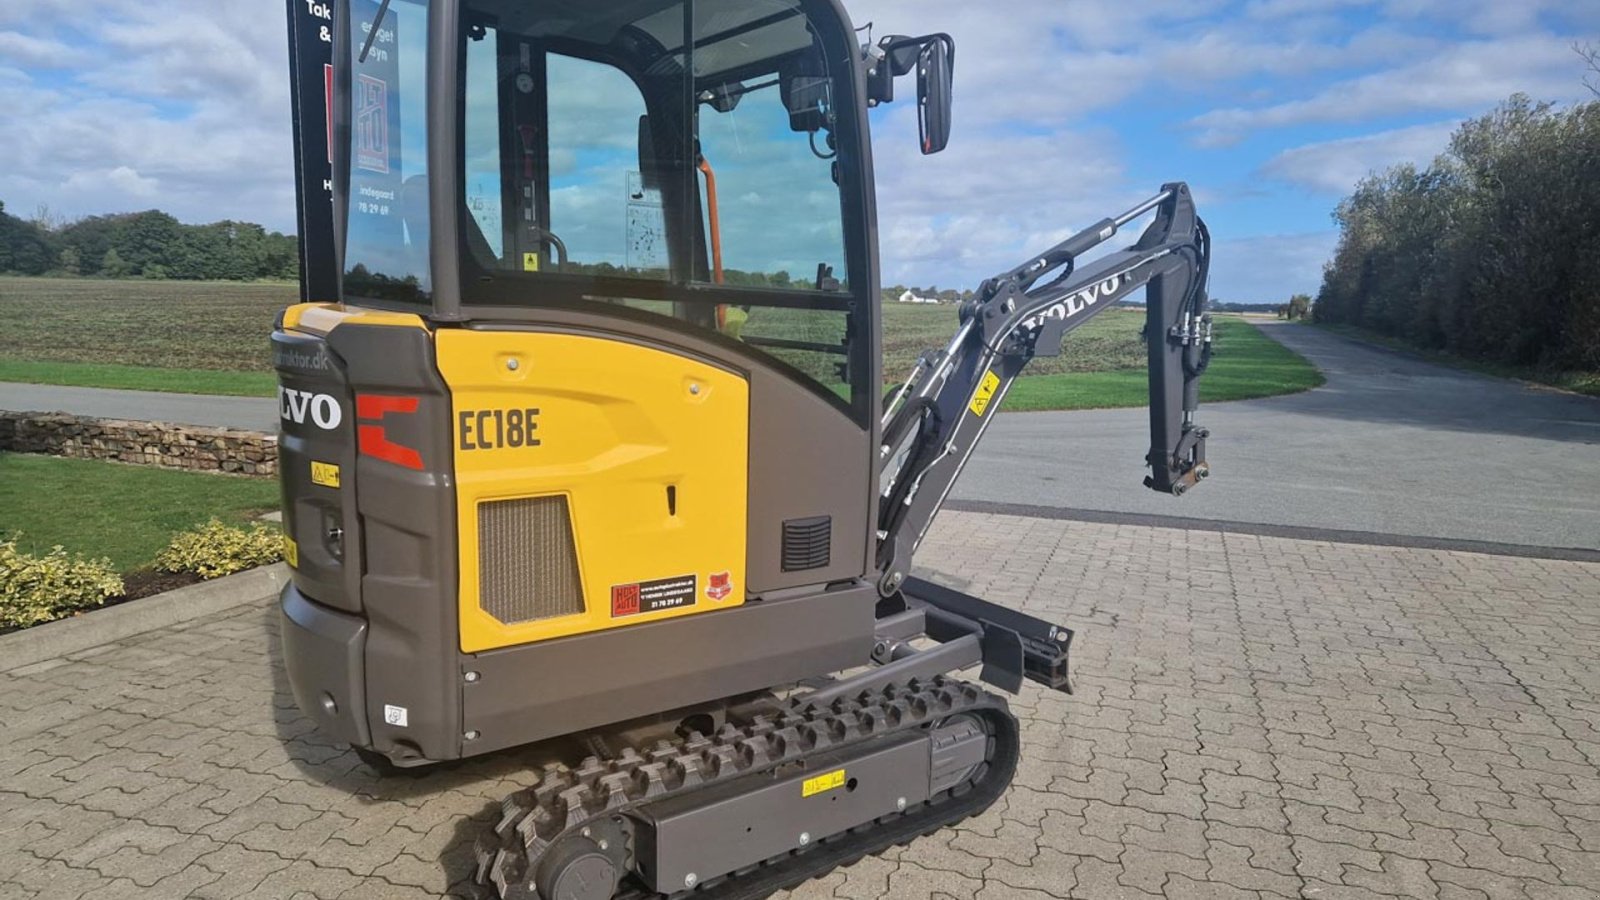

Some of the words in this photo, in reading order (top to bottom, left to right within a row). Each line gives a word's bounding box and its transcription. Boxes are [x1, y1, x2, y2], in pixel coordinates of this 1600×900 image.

[306, 0, 331, 20] Tak
[320, 25, 332, 43] &
[323, 179, 333, 191] H
[359, 184, 395, 201] indegaard
[278, 384, 342, 430] LVO
[459, 408, 541, 450] EC18E
